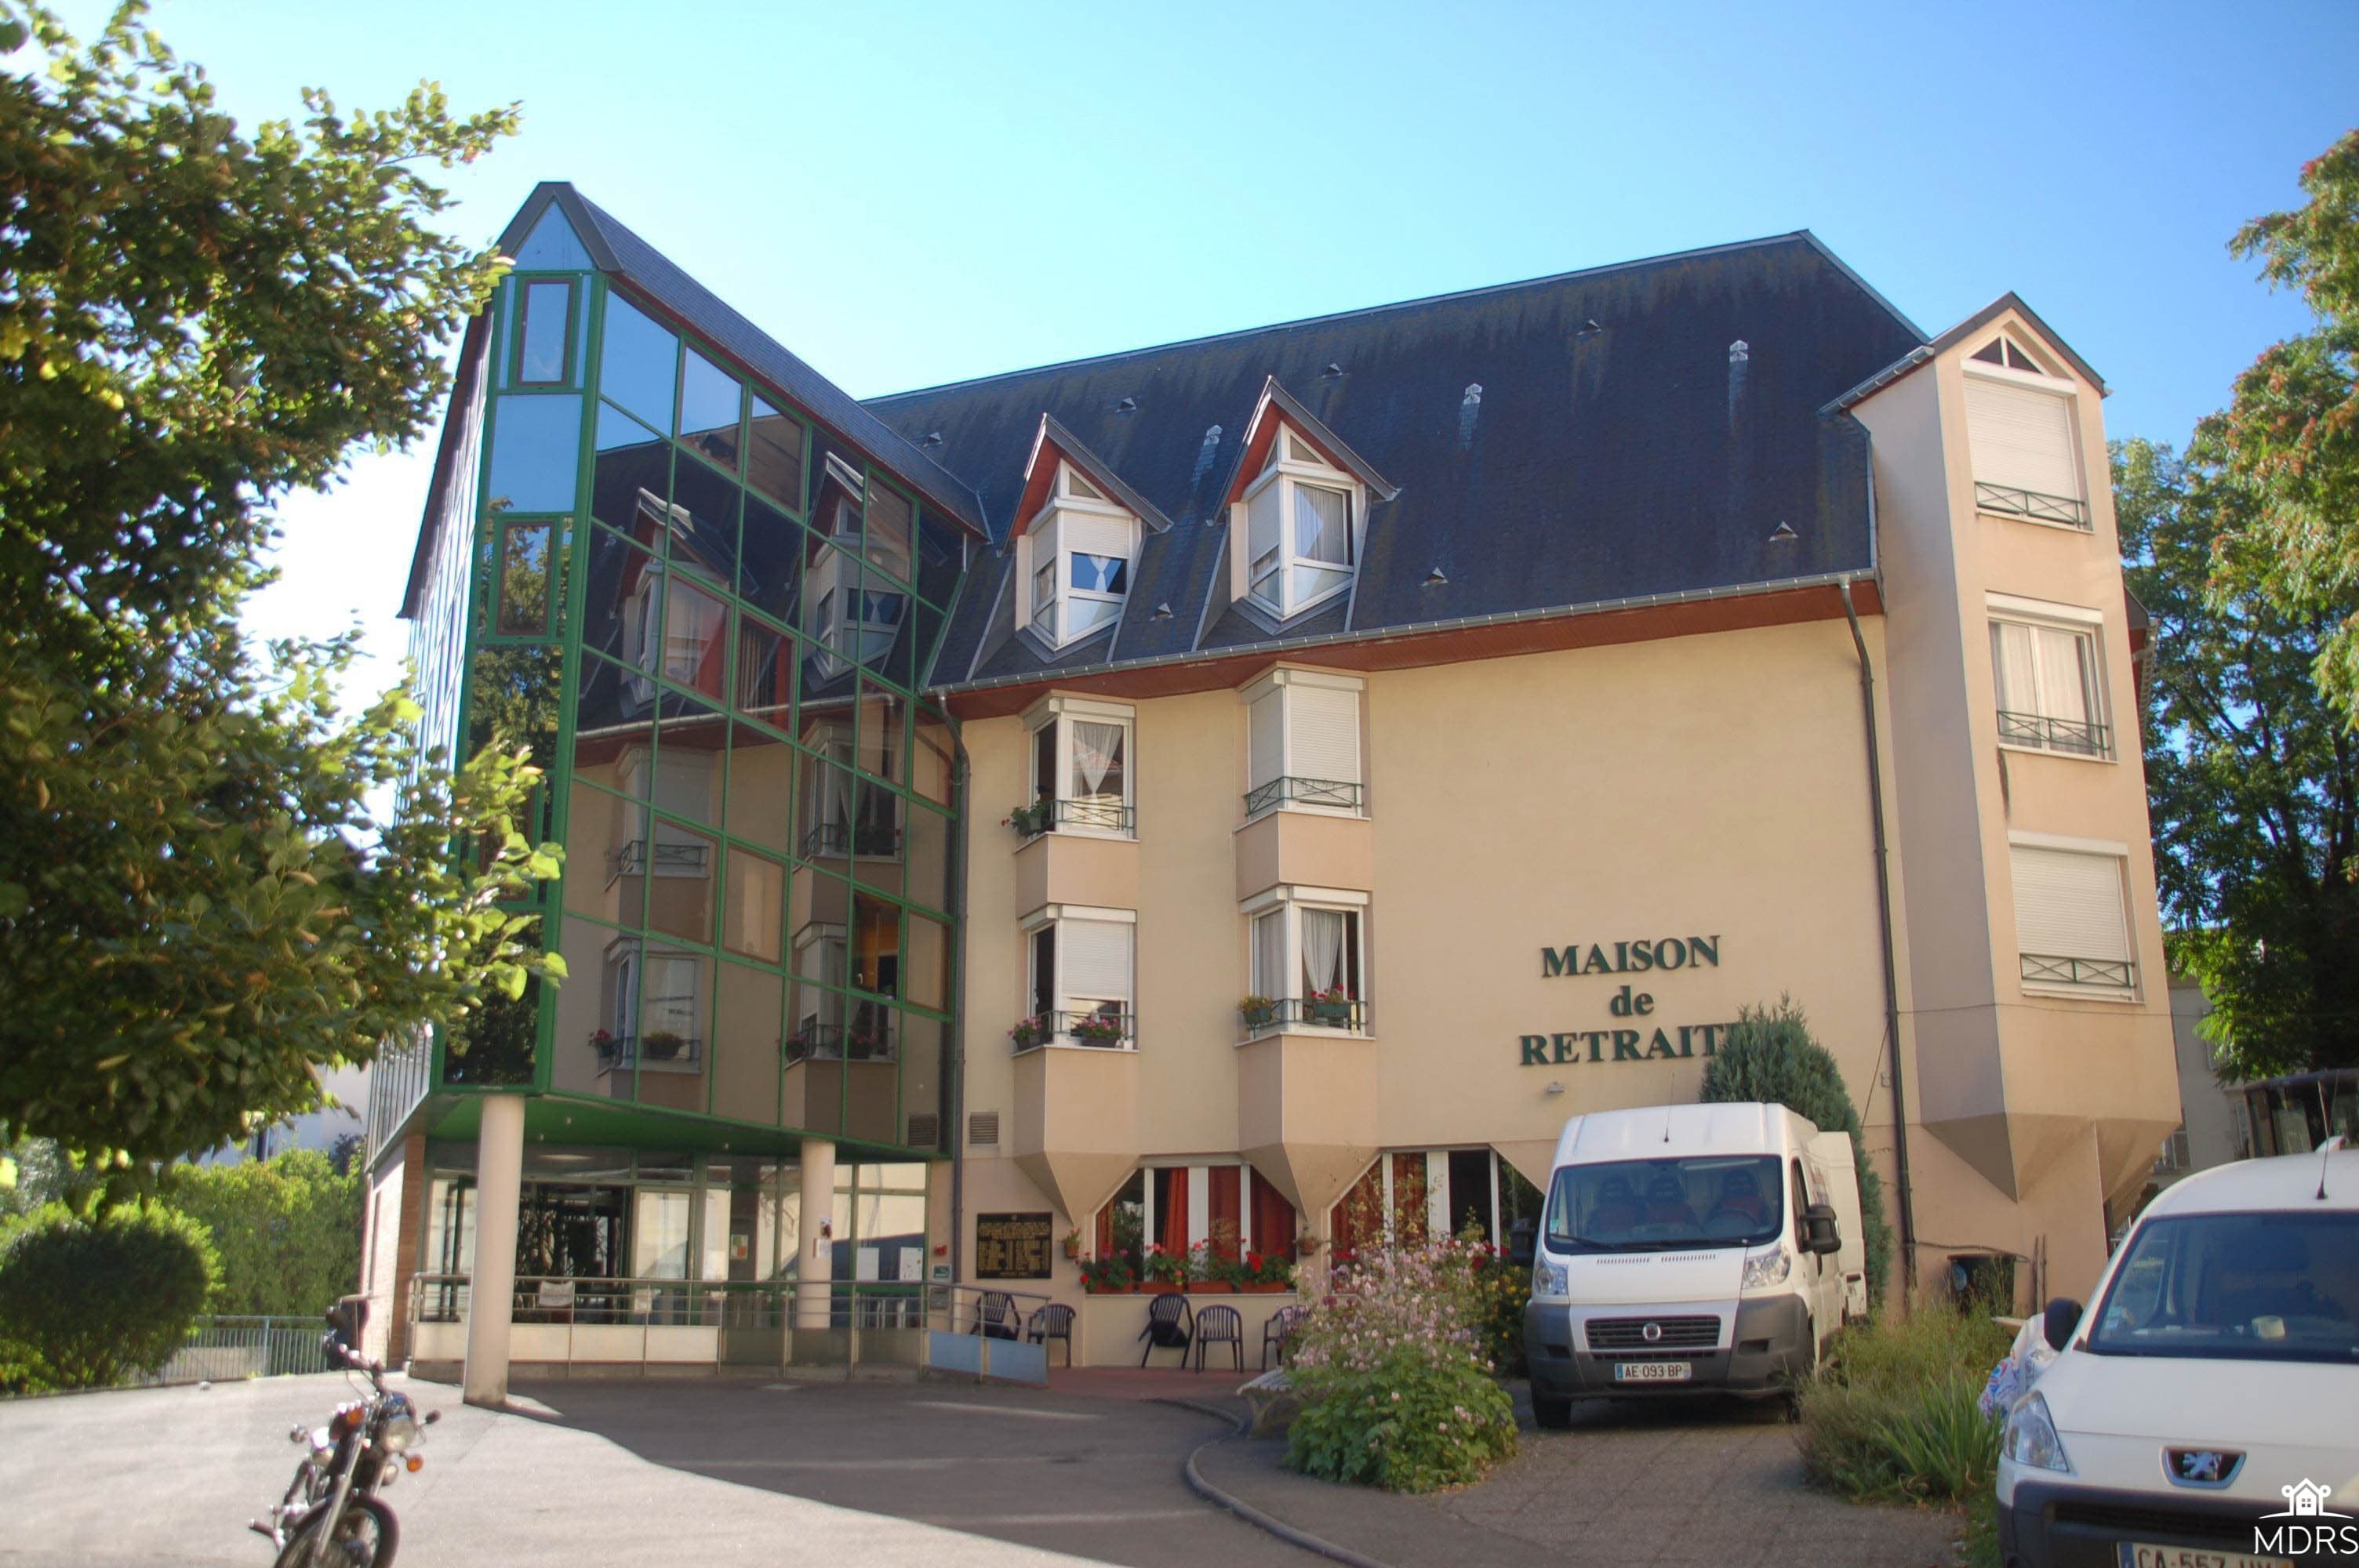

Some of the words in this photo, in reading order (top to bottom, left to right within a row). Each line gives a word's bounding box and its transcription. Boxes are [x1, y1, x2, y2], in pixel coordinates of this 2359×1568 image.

[1541, 935, 1721, 977] MAISON
[1610, 985, 1655, 1016] de
[1519, 1022, 1744, 1065] RETRAIT
